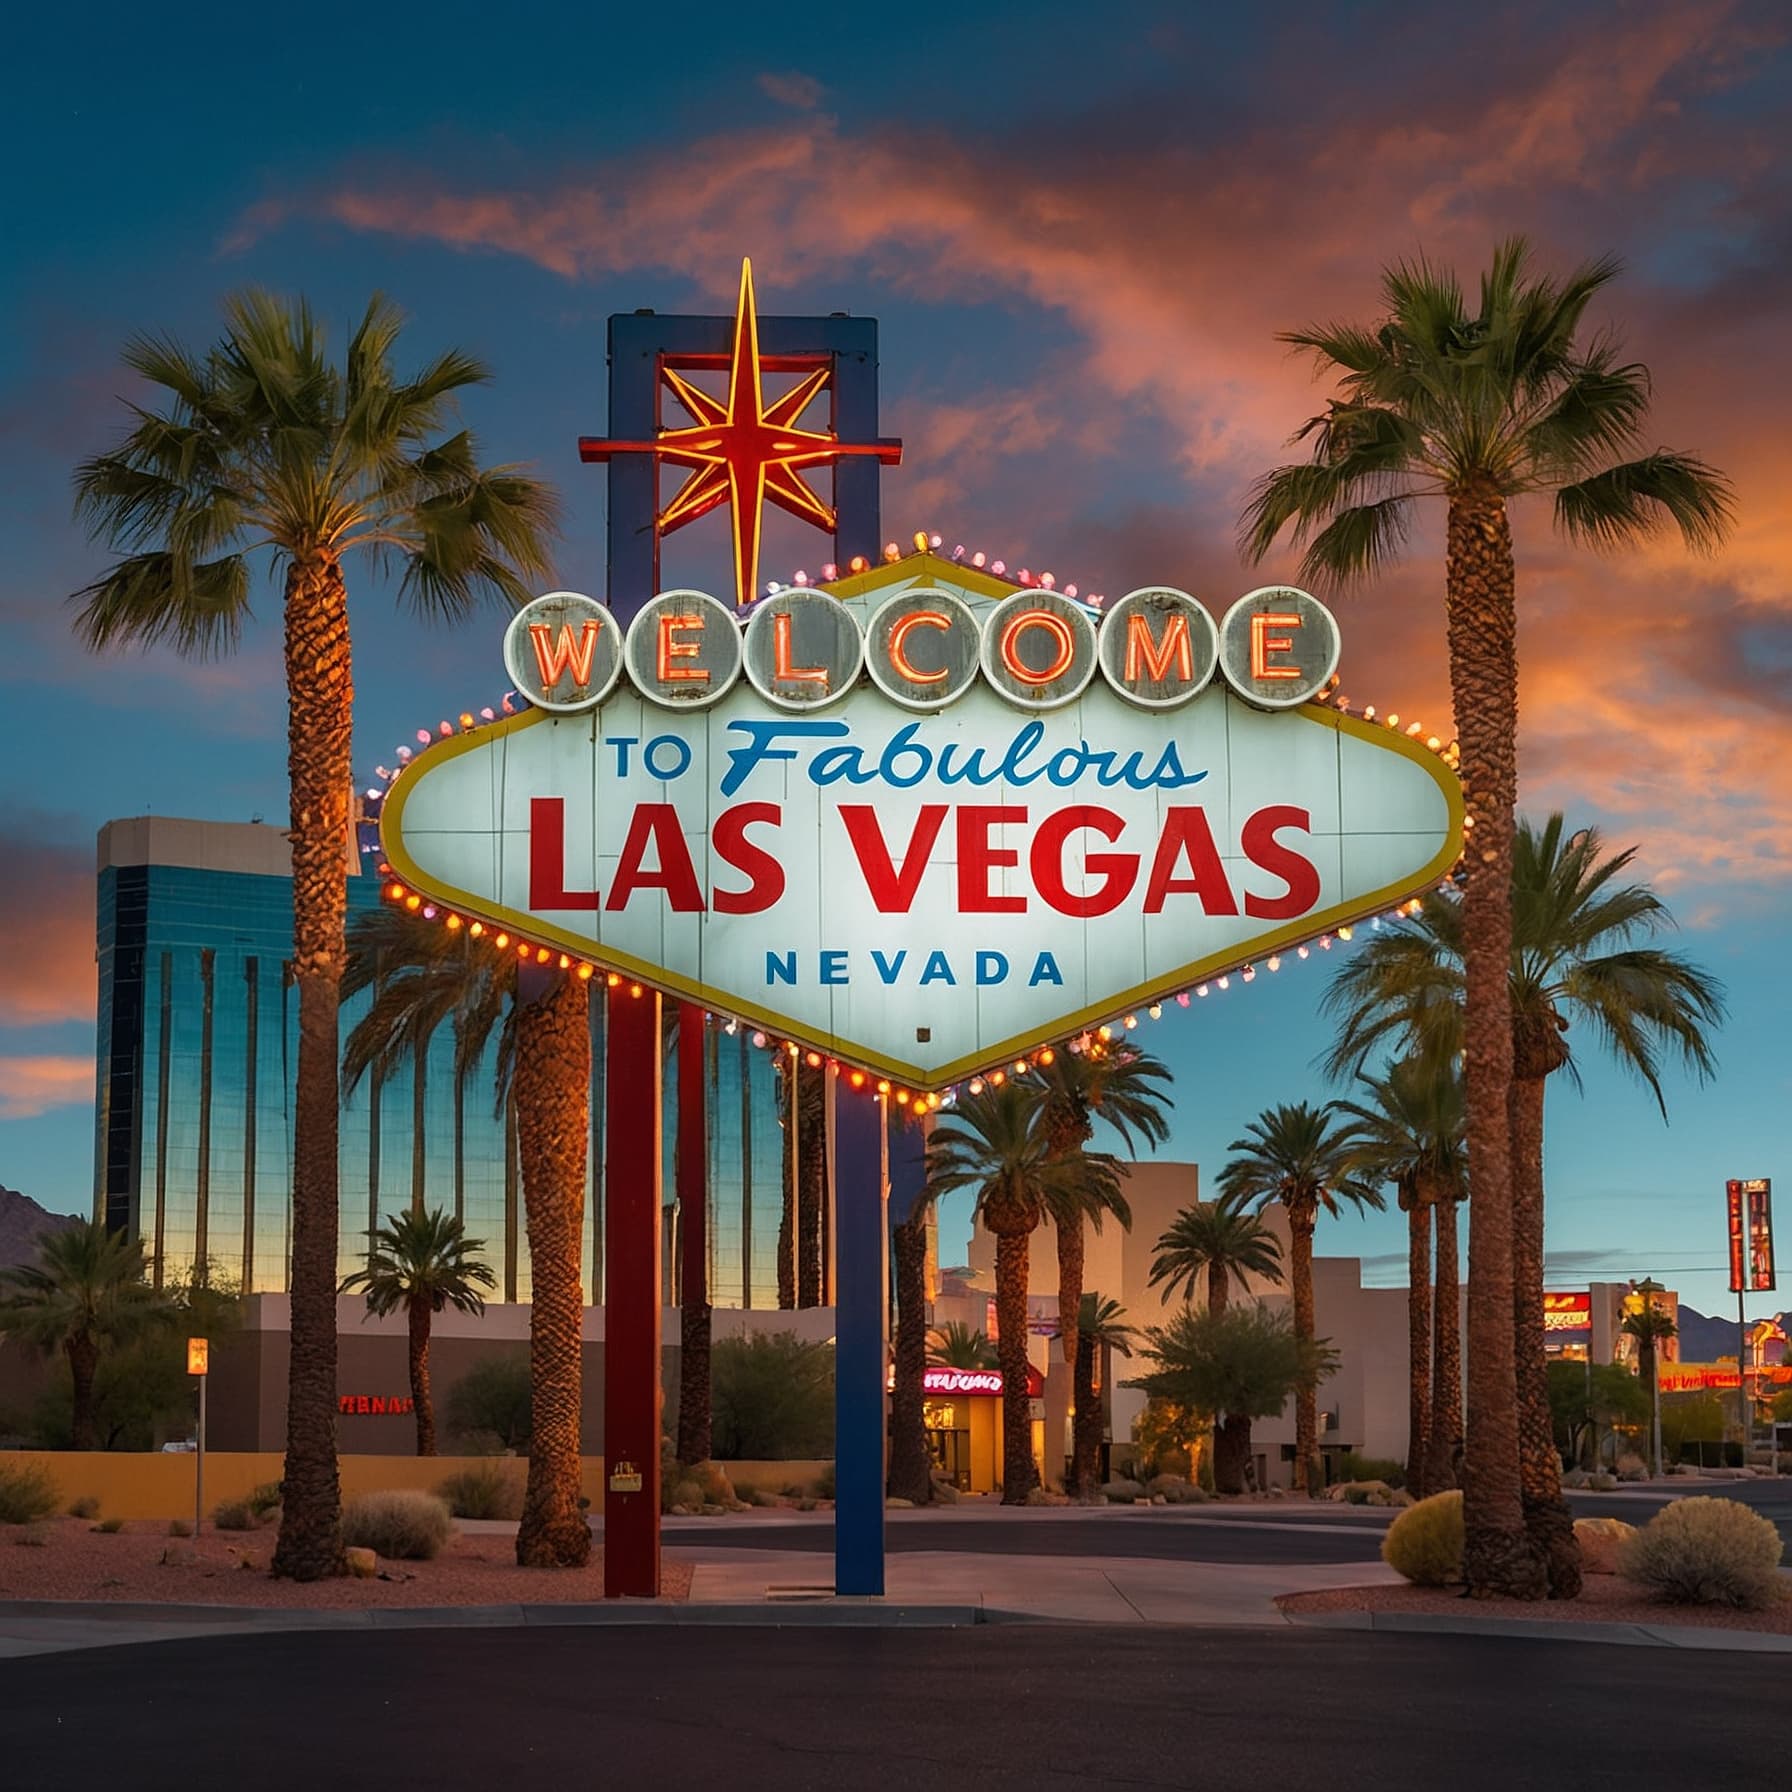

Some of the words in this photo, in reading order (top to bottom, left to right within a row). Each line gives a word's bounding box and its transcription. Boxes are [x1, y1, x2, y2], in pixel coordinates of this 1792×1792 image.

[529, 608, 1302, 686] WELCOME
[606, 735, 693, 781] TO
[720, 719, 1209, 798] Fabulous
[529, 798, 786, 914] LAS
[837, 804, 1321, 919] VEGAS
[766, 949, 1064, 987] NEVADA
